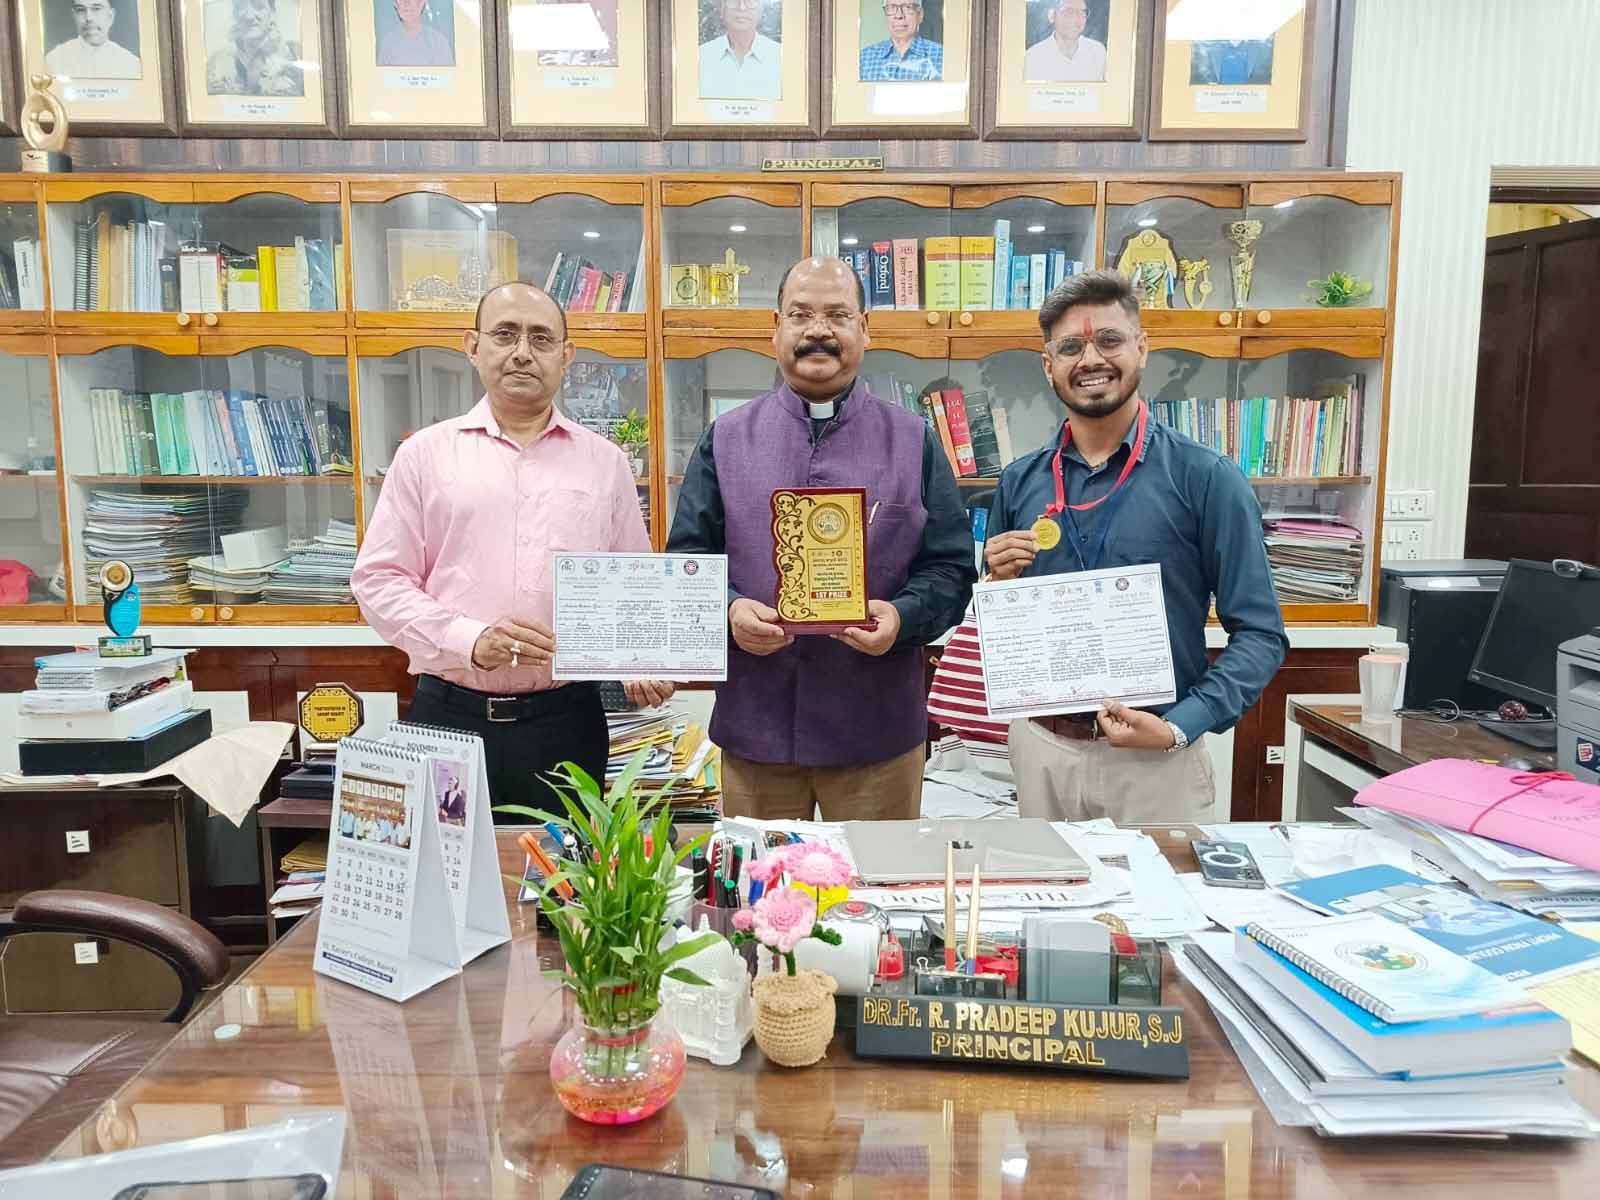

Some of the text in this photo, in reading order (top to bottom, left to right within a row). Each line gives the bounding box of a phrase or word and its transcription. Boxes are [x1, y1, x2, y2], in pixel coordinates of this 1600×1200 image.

[771, 159, 875, 169] PRINCIPAL
[879, 255, 890, 290] Oxford
[361, 762, 381, 772] MARCH
[928, 1002, 950, 1029] R.
[955, 1002, 1057, 1036] PRADEEP
[931, 1032, 1105, 1066] PRINCIPAL
